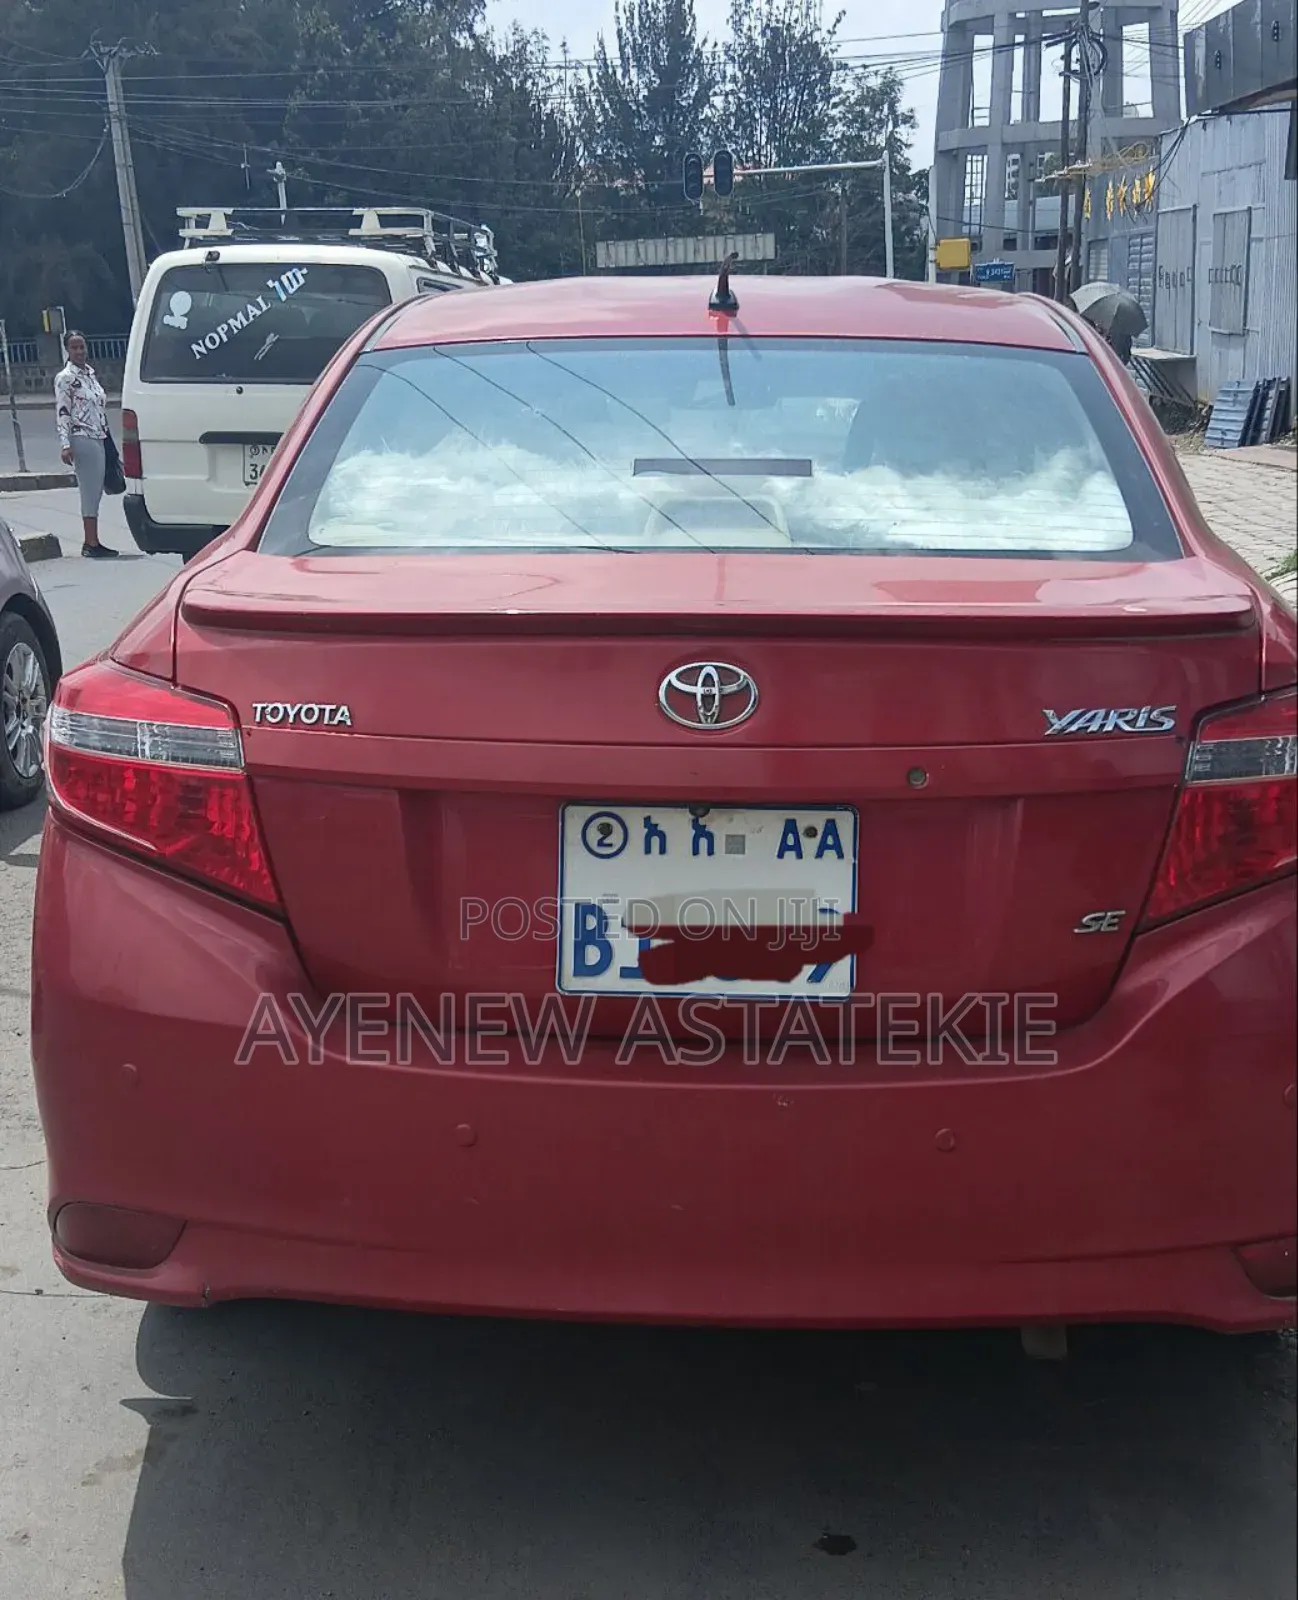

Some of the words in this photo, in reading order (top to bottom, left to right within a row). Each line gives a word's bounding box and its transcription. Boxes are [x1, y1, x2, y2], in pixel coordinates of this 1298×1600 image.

[252, 702, 352, 726] TOYOTA
[1042, 705, 1177, 736] YARIS
[1073, 910, 1126, 933] SE
